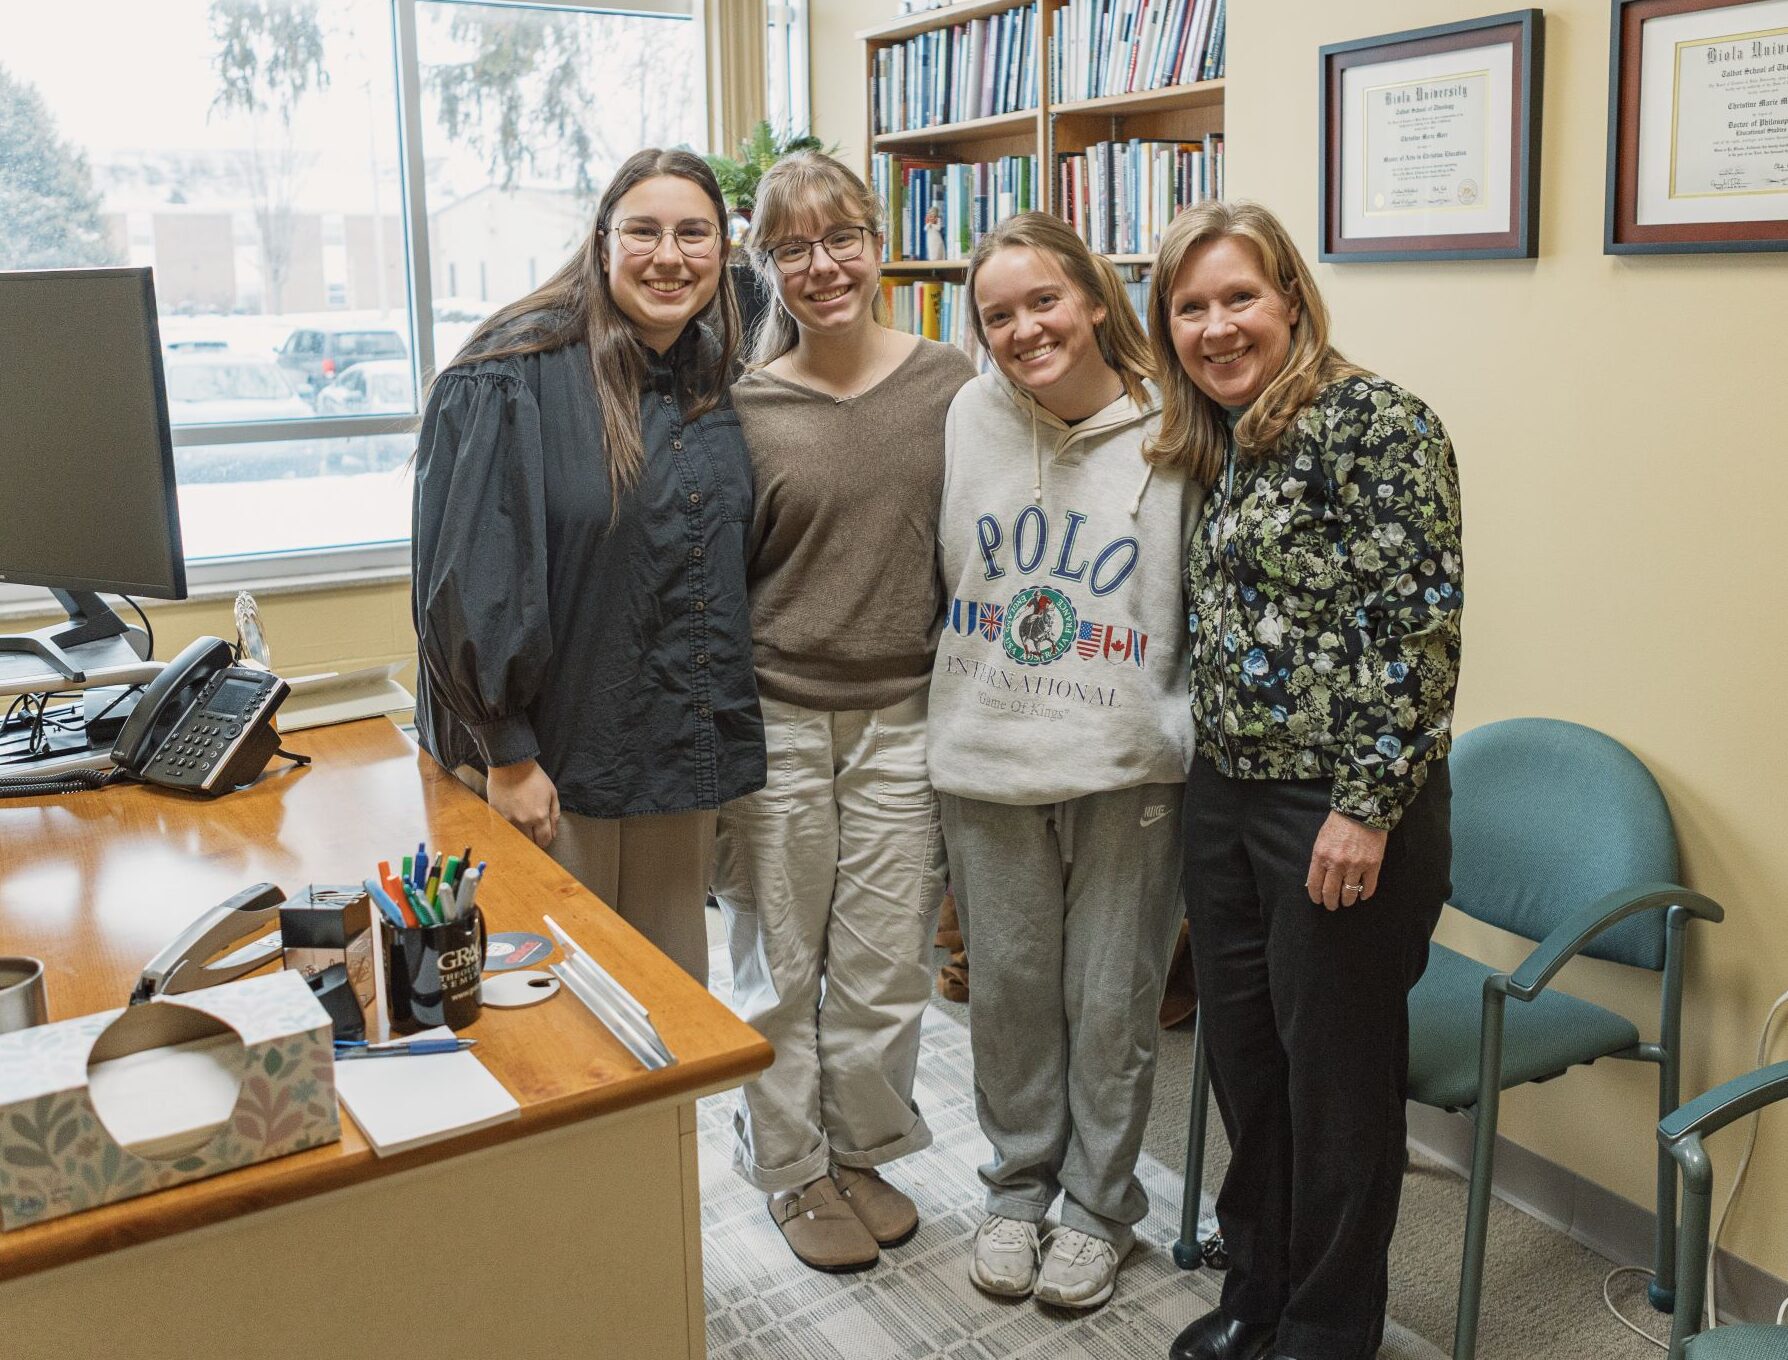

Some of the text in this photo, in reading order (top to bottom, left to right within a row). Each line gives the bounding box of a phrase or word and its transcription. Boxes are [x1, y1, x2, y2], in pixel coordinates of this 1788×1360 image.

[1707, 46, 1743, 64] Biola
[1744, 66, 1766, 75] School
[1416, 84, 1468, 101] University
[1727, 102, 1757, 110] Christine
[1759, 99, 1778, 107] Marie
[1728, 121, 1748, 129] Doctor
[976, 504, 1140, 598] POLO
[1005, 637, 1017, 655] USA
[1056, 598, 1073, 634] FRANCE
[947, 655, 1122, 707] INTERNATIONAL
[1144, 804, 1167, 818] NIKE
